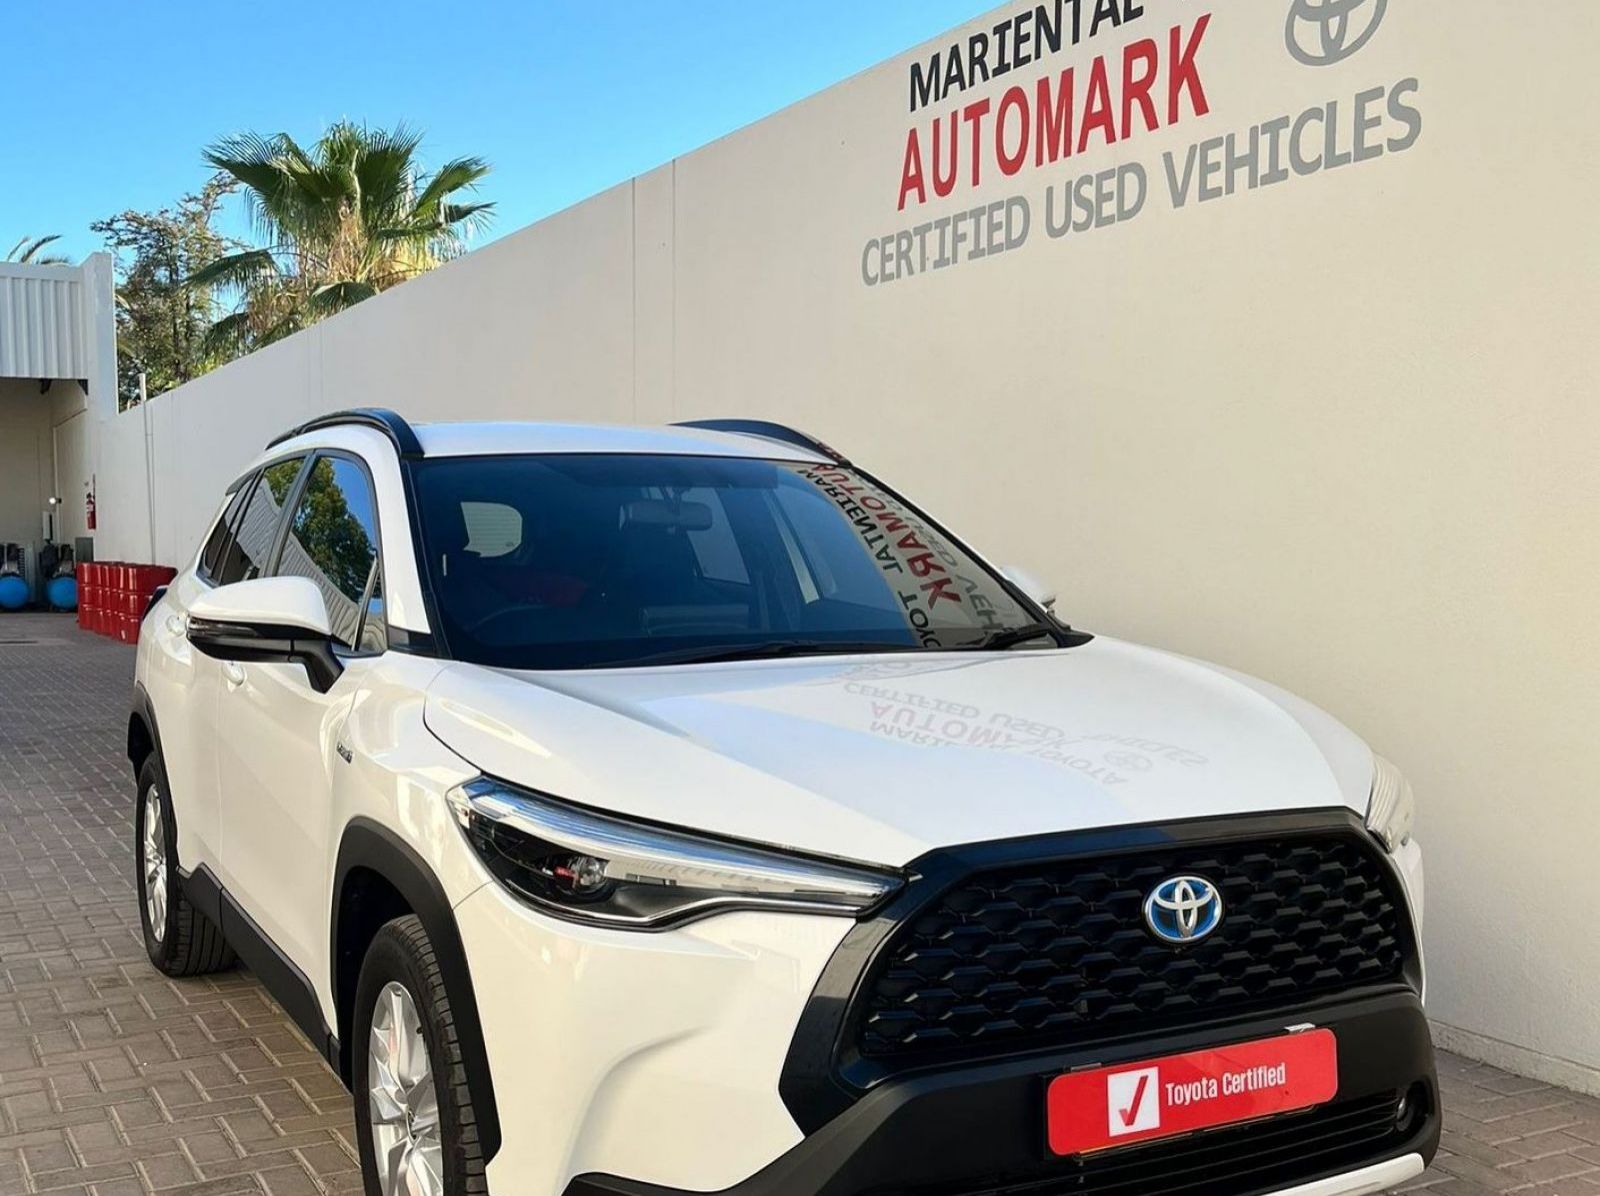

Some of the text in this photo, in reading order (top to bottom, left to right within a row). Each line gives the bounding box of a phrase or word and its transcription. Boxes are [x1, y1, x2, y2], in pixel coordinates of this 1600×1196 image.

[861, 77, 1422, 286] CERTIFIED USED VEHICLES
[897, 13, 1211, 211] AUTOMARK
[1166, 1062, 1286, 1106] Toyota Certified
